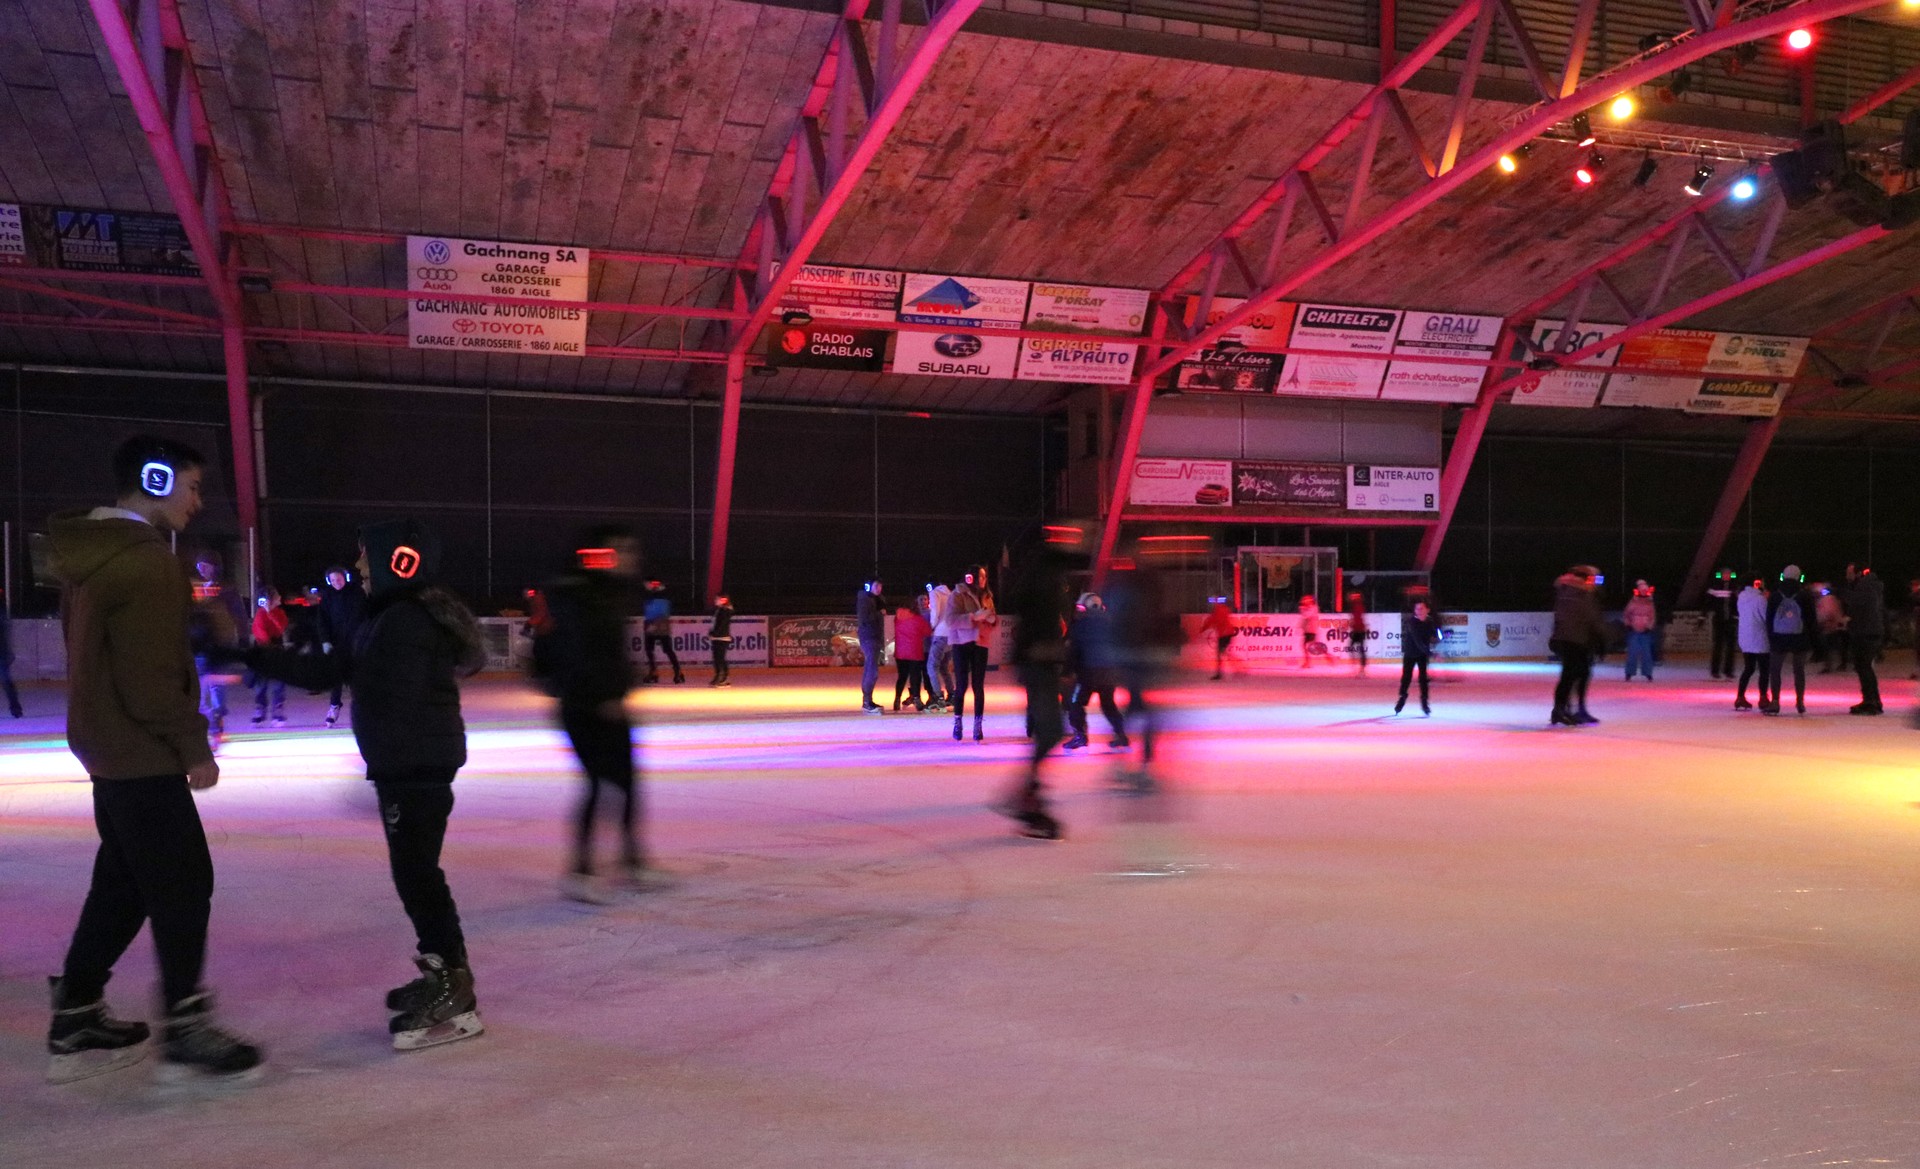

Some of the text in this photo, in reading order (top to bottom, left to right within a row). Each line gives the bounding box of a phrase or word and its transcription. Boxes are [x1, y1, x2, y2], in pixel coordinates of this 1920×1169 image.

[463, 243, 577, 264] Gachnang SA
[495, 263, 547, 275] GARAGE
[481, 273, 561, 287] CARROSSERIE
[849, 270, 881, 288] ATLAS
[884, 273, 898, 288] SA
[423, 281, 452, 291] Audi
[491, 286, 551, 297] 1860 AIGLE
[1054, 296, 1106, 307] D'ORSAY
[416, 299, 581, 321] GACHNANG AUTOMOBILES
[1306, 311, 1379, 326] CHATELET
[1425, 315, 1481, 334] GRAU
[480, 321, 545, 335] TOYOTA
[812, 332, 855, 345] RADIO
[530, 341, 550, 350] 1860
[553, 342, 579, 352] AIGLE
[811, 344, 874, 358] CHABLAIS
[1028, 339, 1103, 353] GARAGE
[1050, 349, 1129, 365] ALPAUTO
[1204, 351, 1226, 362] Le
[918, 361, 990, 376] SUBARU
[1390, 372, 1479, 384] roth échafaudages
[1706, 381, 1772, 394] GOODYEAR
[1374, 470, 1435, 481] INTER-AUTO
[775, 639, 828, 648] BARS DISCO
[775, 647, 809, 656] RESTOS
